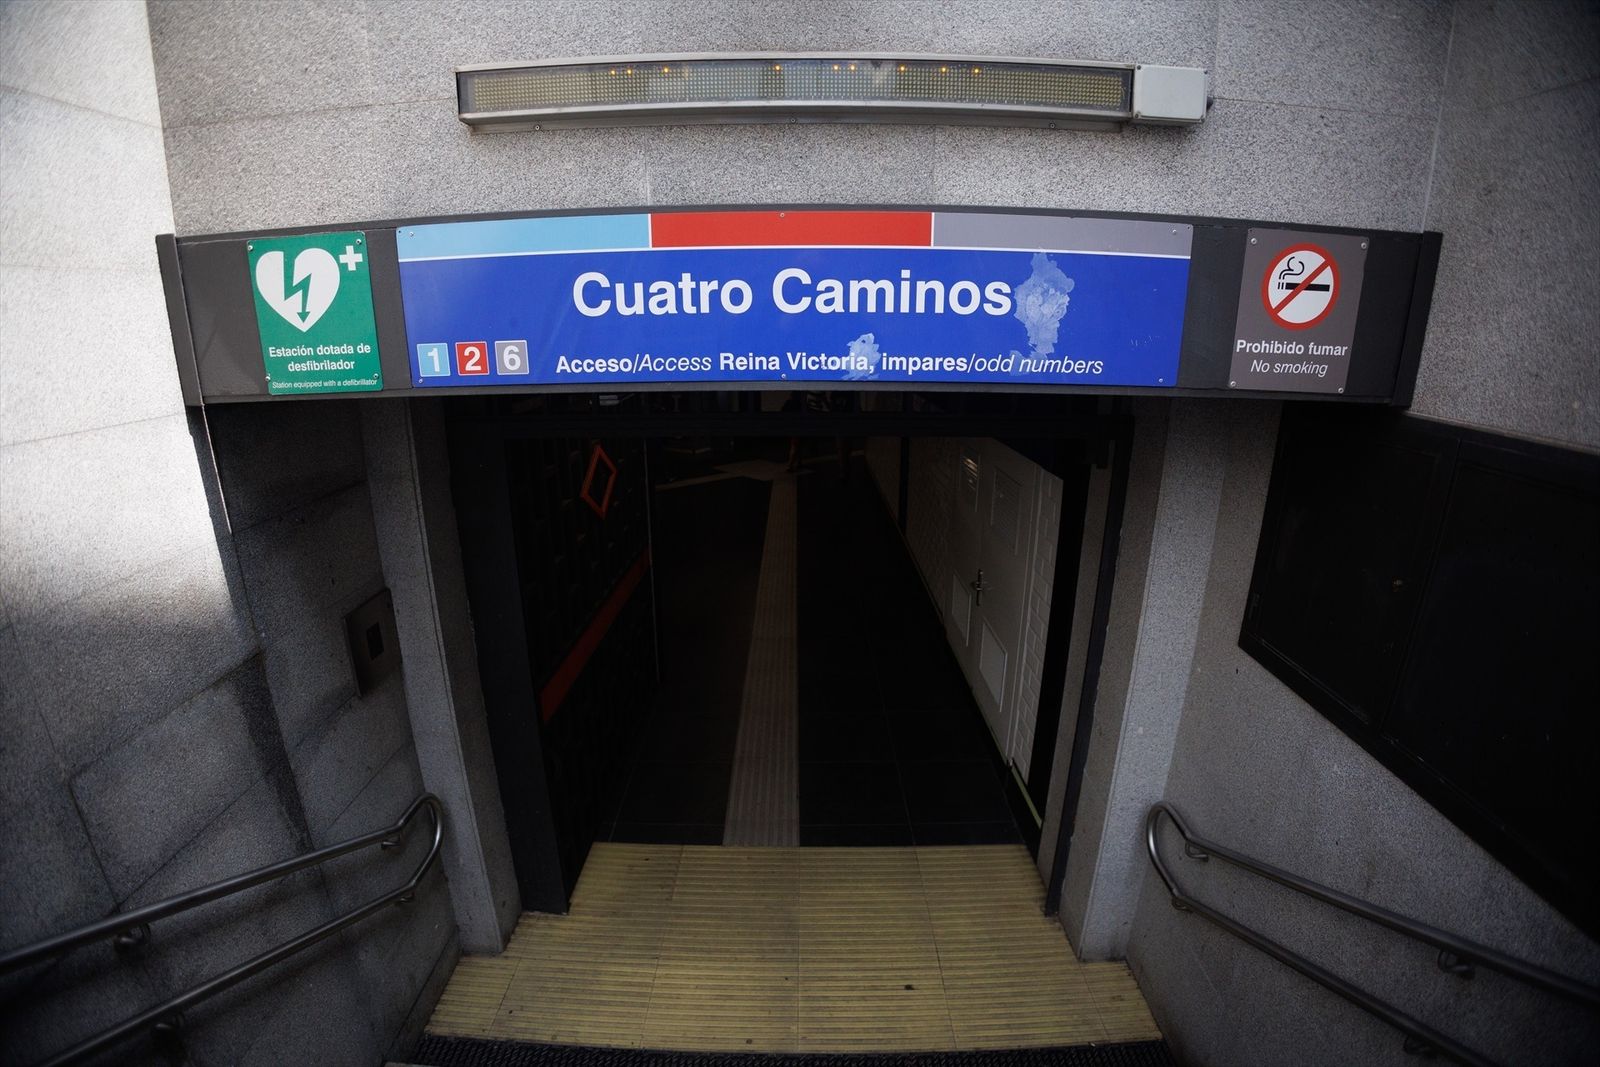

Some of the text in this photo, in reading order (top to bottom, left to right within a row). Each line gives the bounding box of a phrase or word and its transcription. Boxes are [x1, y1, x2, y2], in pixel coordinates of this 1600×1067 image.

[572, 268, 1012, 317] Cuatro Caminos
[268, 343, 371, 357] Estación dotada de
[1236, 339, 1348, 356] Prohibido fumar
[287, 359, 356, 372] desfibrilador
[427, 346, 521, 372] 1 2 6
[556, 352, 1104, 375] Acceso/Access Reina Victoria, impares/odd numbers
[1250, 359, 1328, 378] No smoking
[272, 381, 292, 389] Station
[293, 381, 322, 389] equipped
